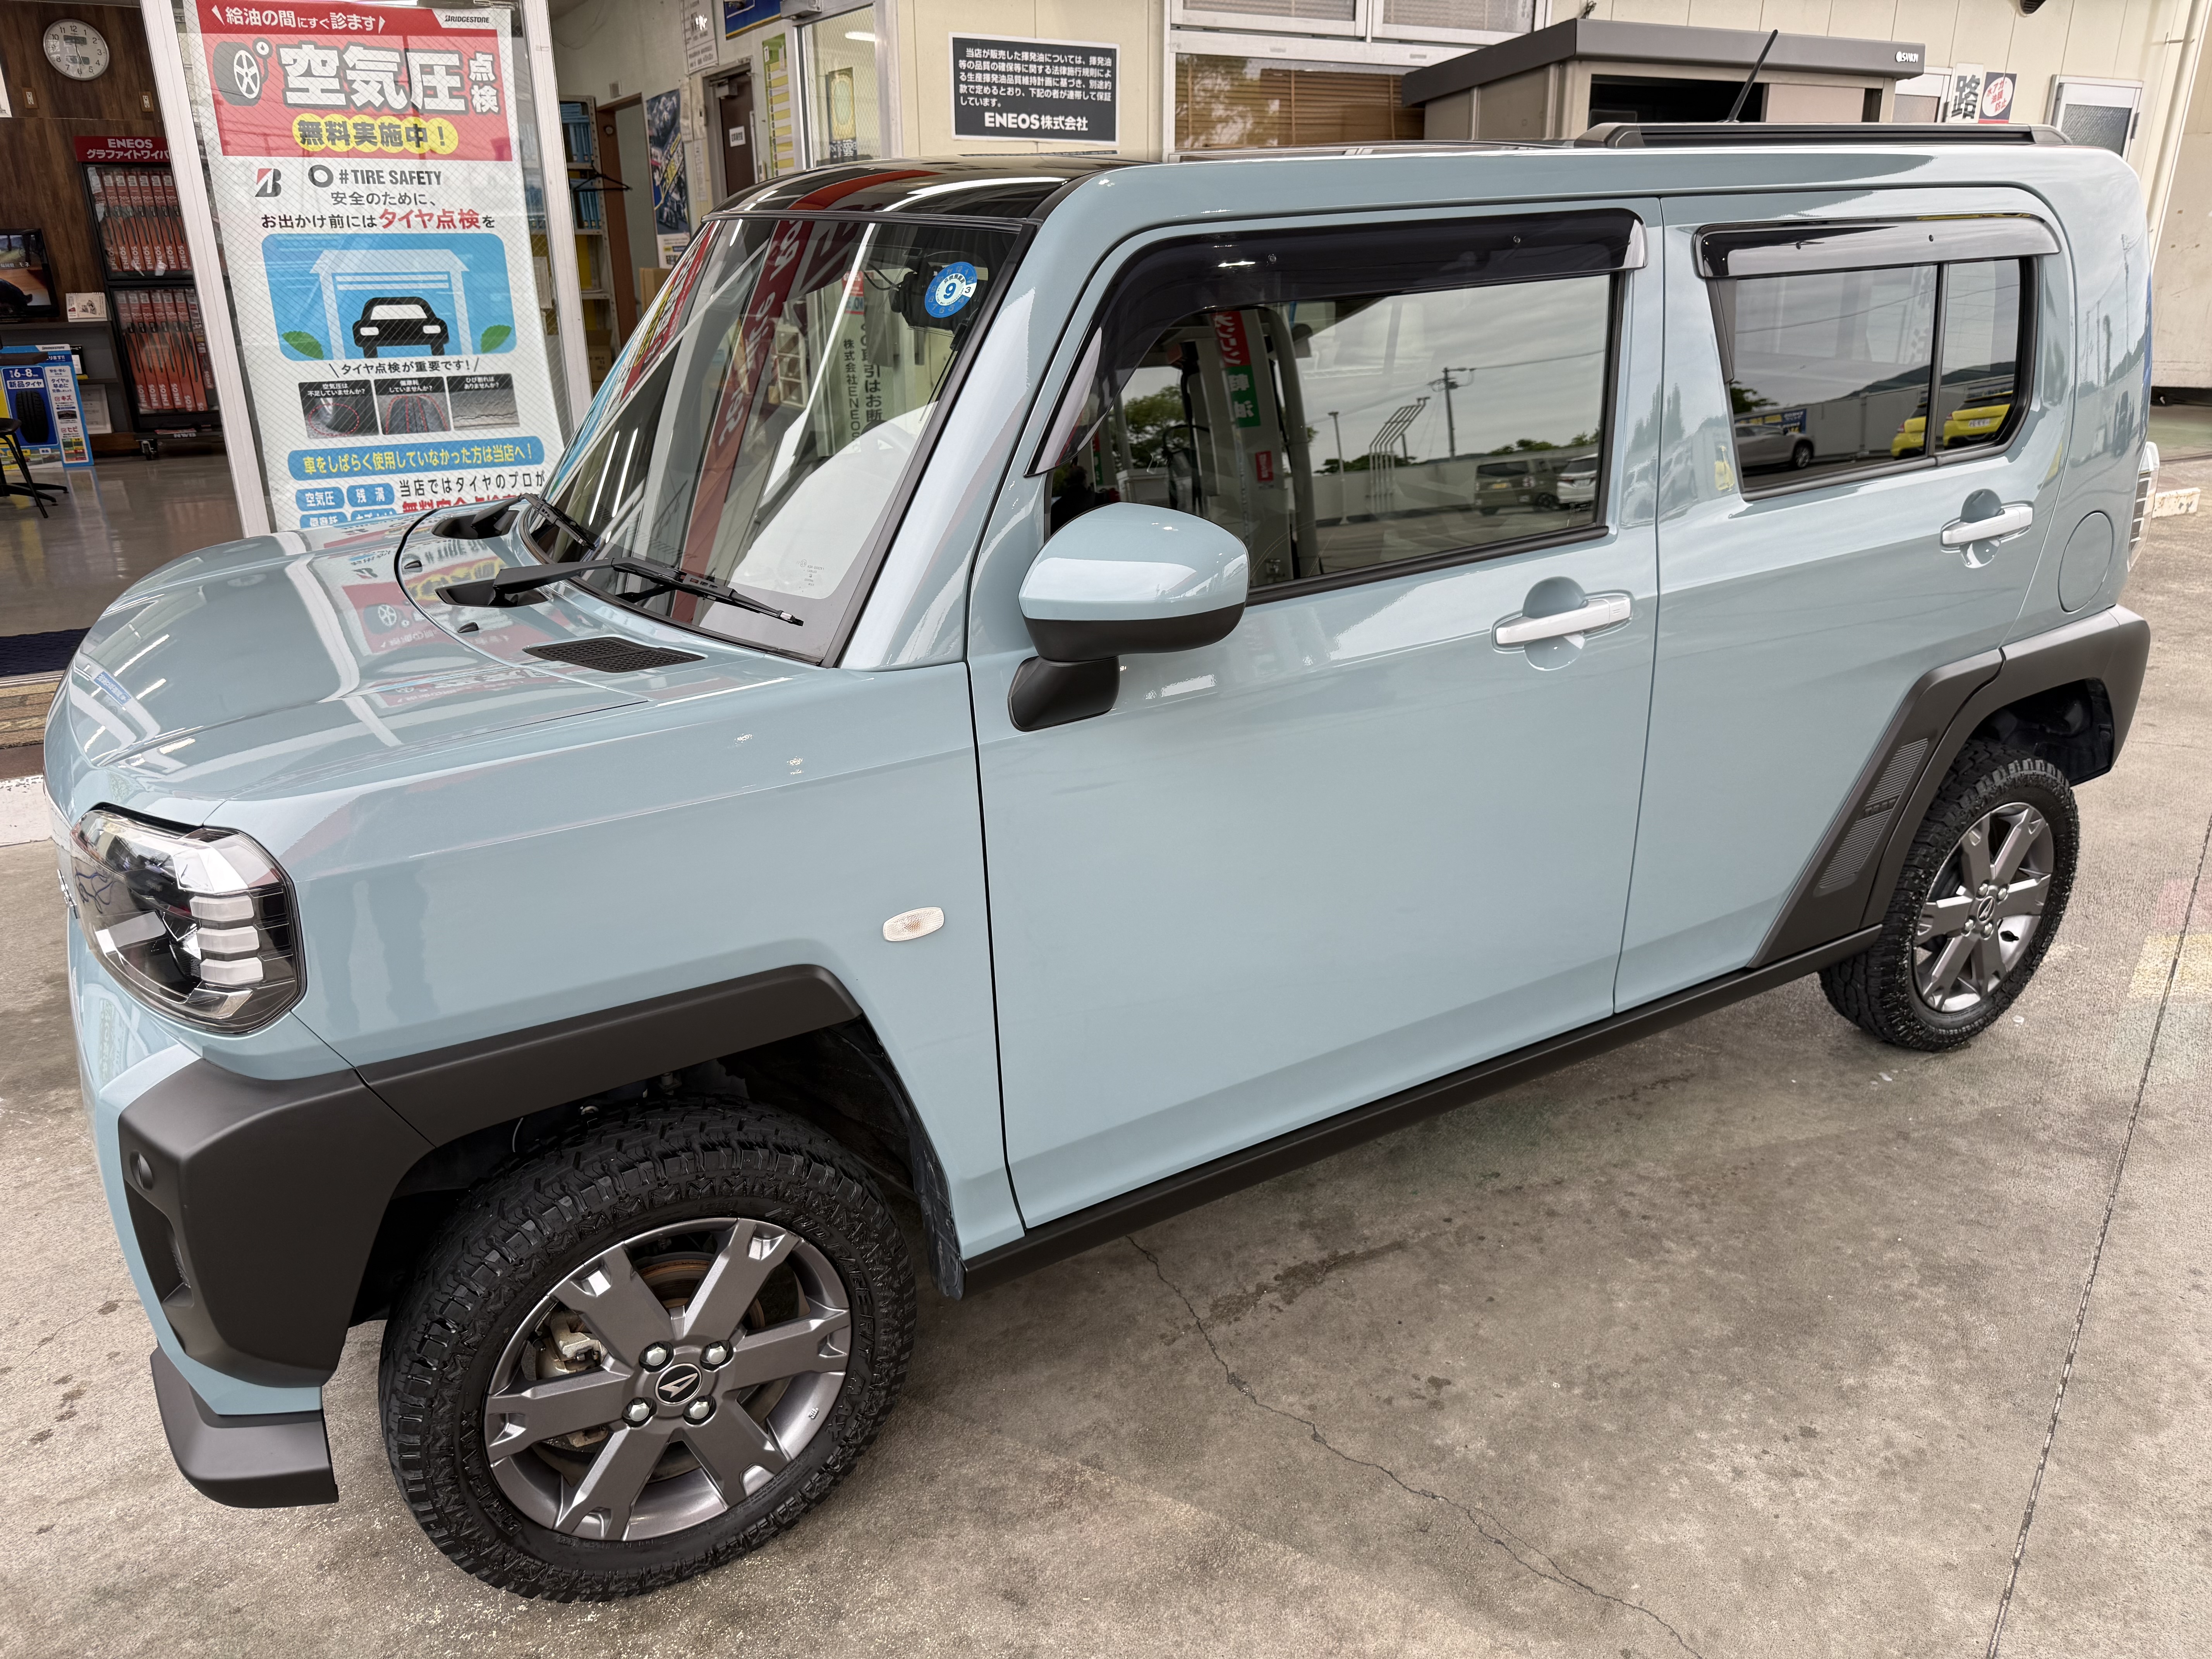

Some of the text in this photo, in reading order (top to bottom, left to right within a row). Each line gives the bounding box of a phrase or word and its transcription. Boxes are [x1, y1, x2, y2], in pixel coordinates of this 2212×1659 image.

[225, 7, 376, 31] 給油の間にすぐ診ます
[444, 14, 490, 24] BRIDGESTONE
[279, 43, 467, 112] 空気圧
[469, 53, 499, 113] 点検
[960, 96, 1001, 107] しています。
[984, 111, 1089, 131] ENEOS株式会社
[107, 138, 153, 149] ENEOS
[389, 170, 442, 185] SAFETY
[331, 191, 436, 207] 安全のために、
[261, 208, 495, 230] お出かけ前にはタイヤ点検を
[119, 246, 130, 269] ENEOS
[143, 246, 153, 269] ENEOS
[166, 245, 177, 268] ENEOS
[178, 245, 188, 268] ENEOS
[943, 282, 957, 299] 9
[159, 384, 170, 406] ENEOS
[170, 383, 182, 406] ENEOS
[399, 470, 545, 498] 当店ではタイヤのプロが
[304, 491, 335, 507] 空気圧
[825, 1369, 866, 1441] MAX
